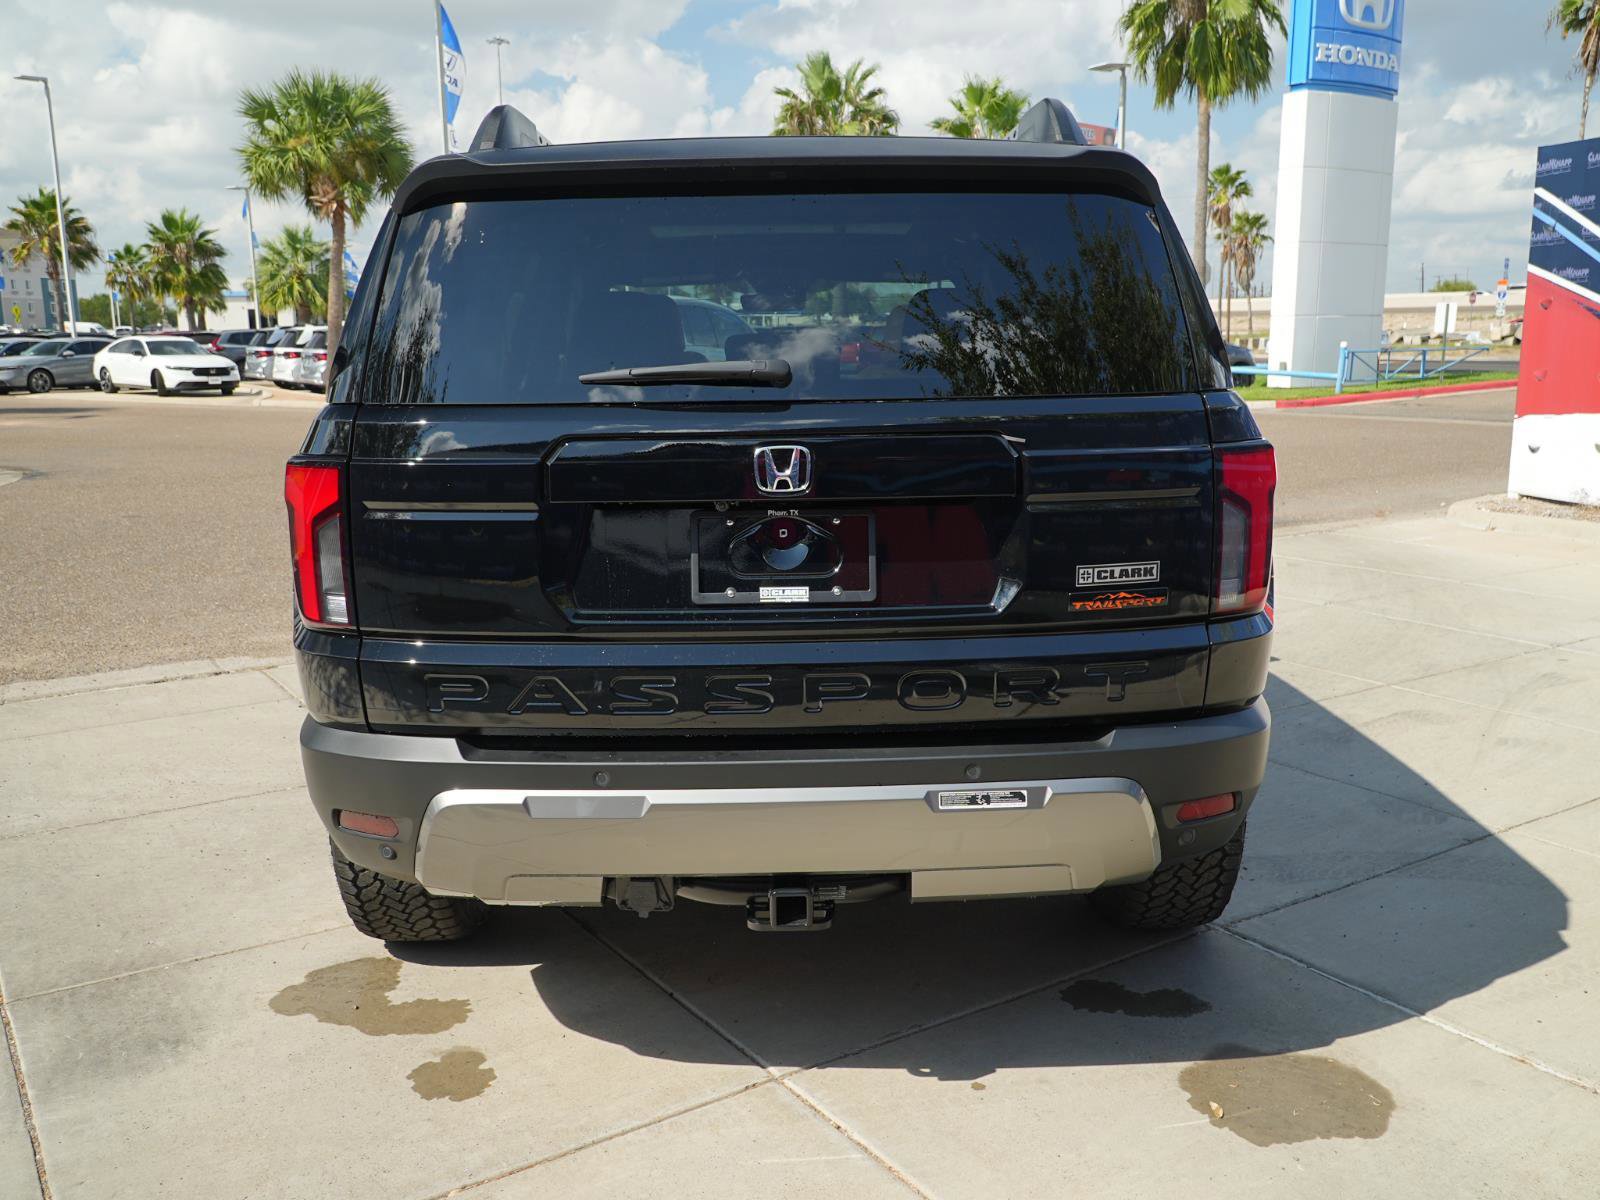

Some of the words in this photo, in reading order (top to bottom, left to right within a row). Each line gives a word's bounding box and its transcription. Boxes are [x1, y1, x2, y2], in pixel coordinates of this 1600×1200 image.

[1316, 43, 1400, 72] HONDA
[1097, 566, 1155, 580] CLARK
[1072, 596, 1165, 610] TRAILSPORT
[423, 660, 1151, 715] PASSPORT
